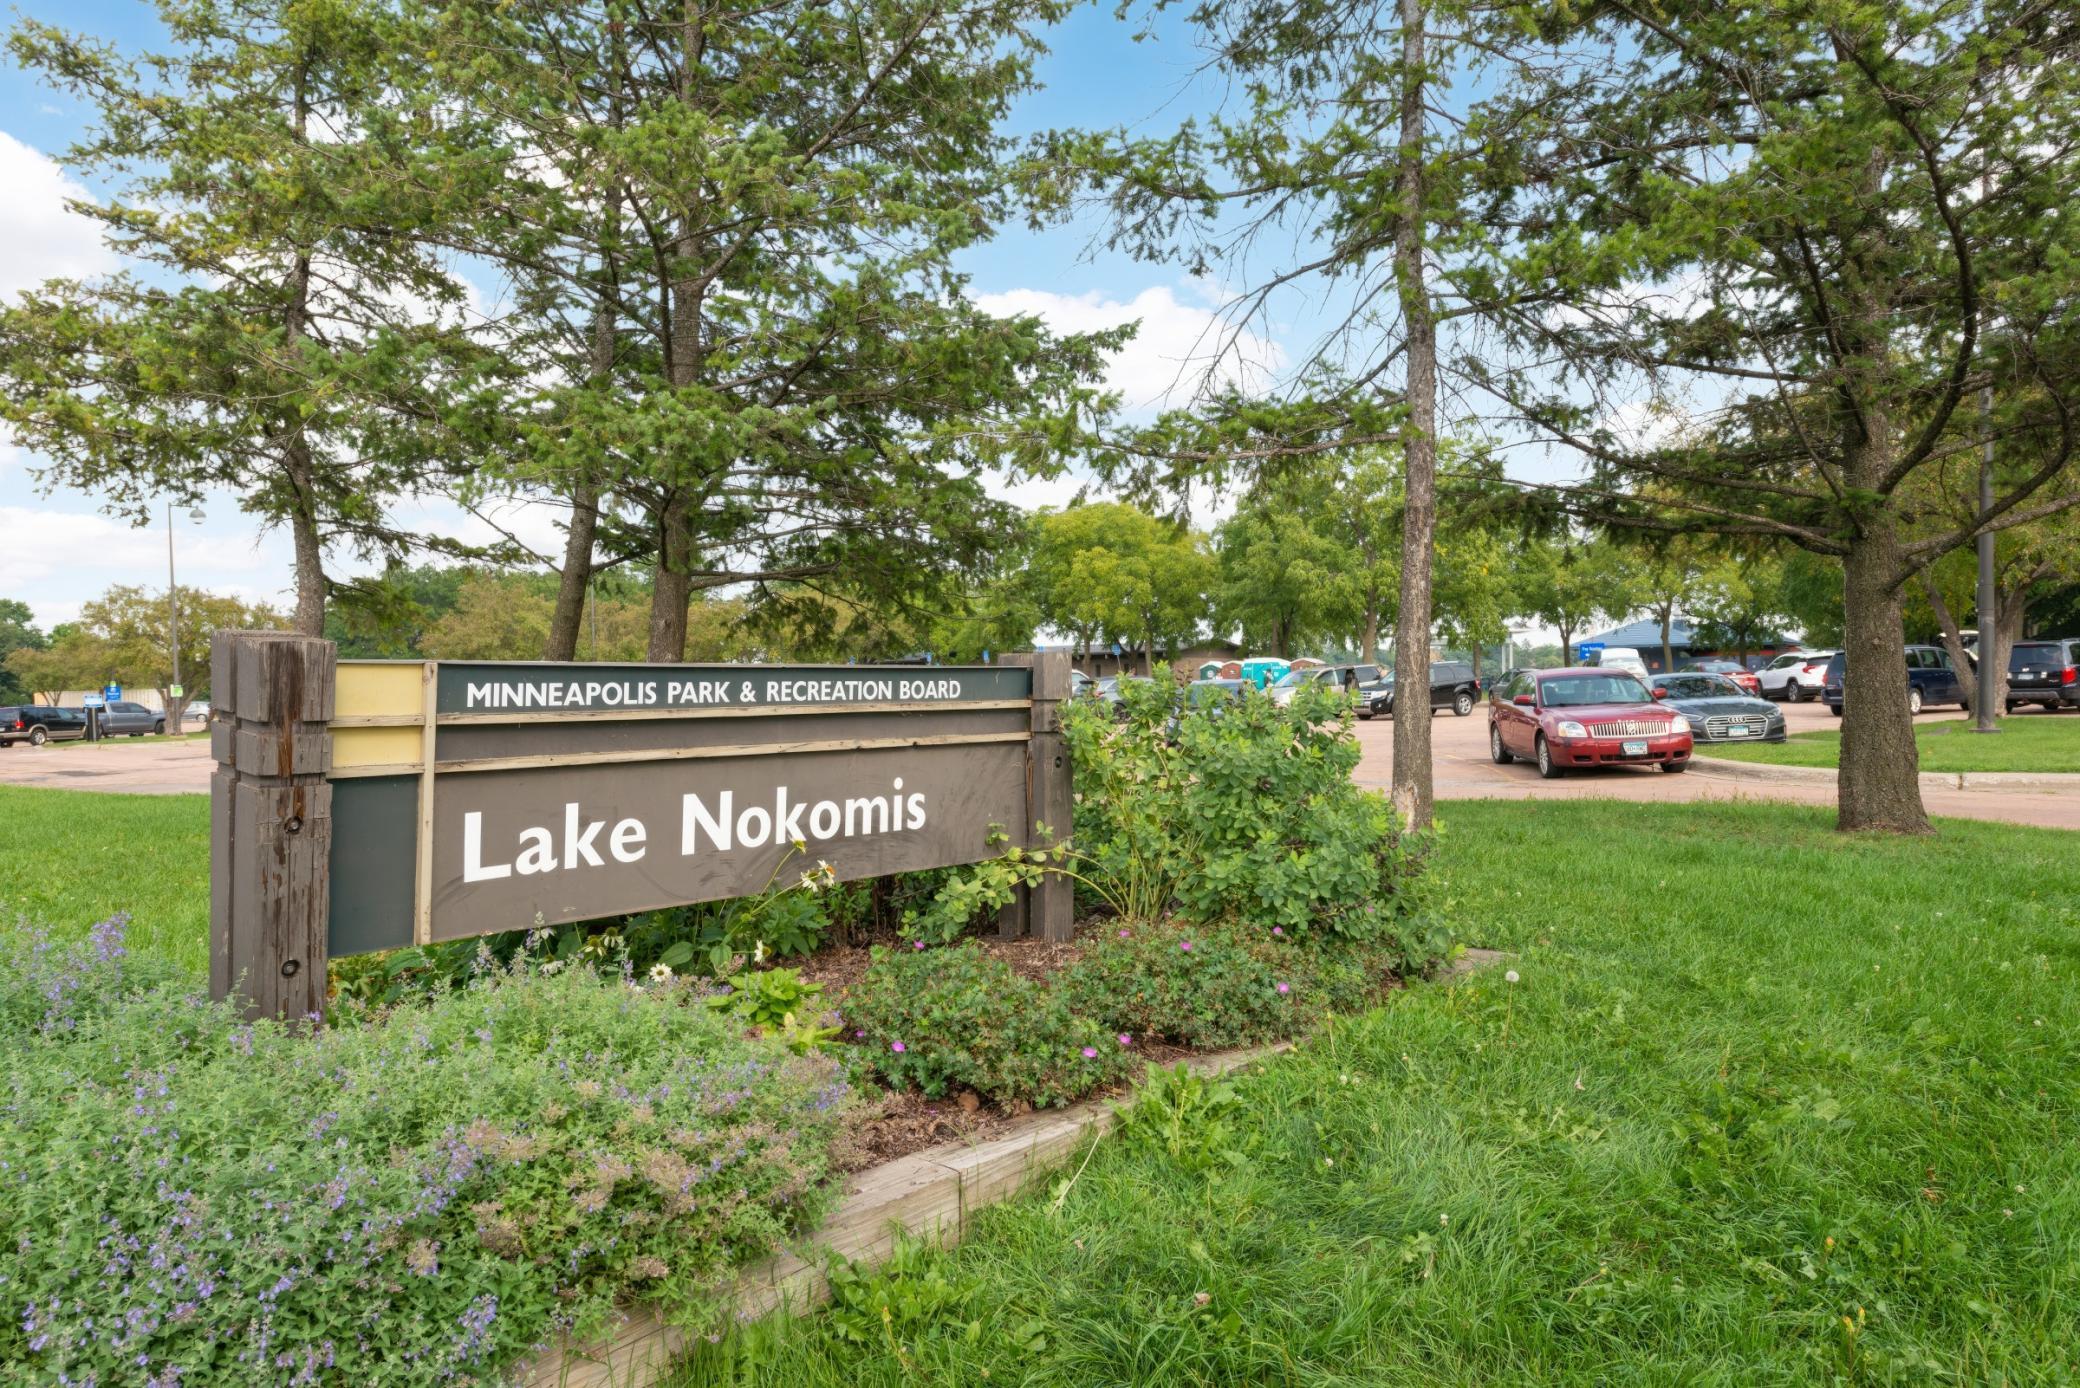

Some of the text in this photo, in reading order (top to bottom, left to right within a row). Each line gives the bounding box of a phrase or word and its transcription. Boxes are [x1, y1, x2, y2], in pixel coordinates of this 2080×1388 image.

[466, 678, 962, 708] MINNEAPOLIS PARK & RECREATION BOARD
[463, 776, 927, 883] Lake Nokomis
